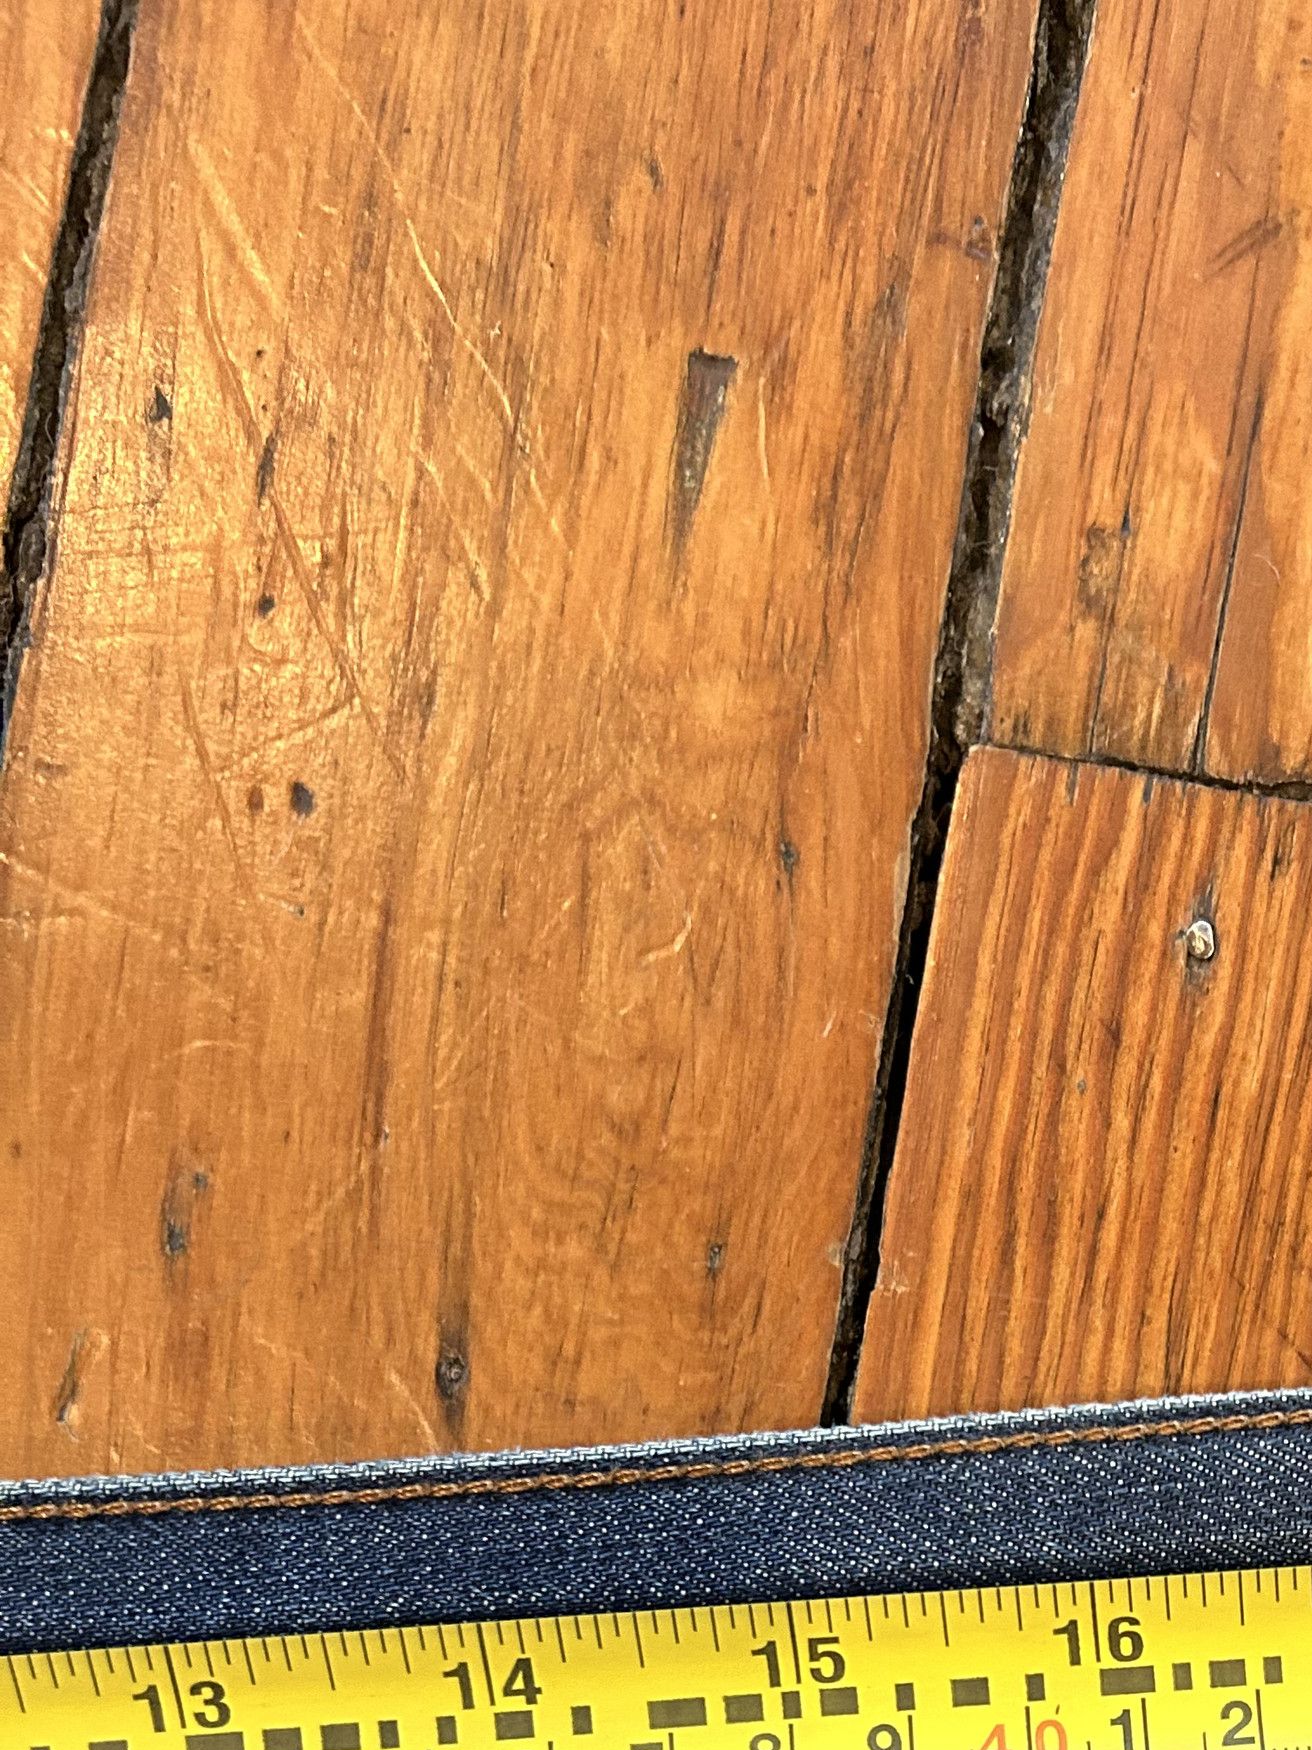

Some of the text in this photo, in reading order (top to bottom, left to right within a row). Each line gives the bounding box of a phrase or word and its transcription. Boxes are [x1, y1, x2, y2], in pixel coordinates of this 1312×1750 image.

[133, 1681, 232, 1733] 13
[443, 1657, 542, 1710] 14
[752, 1636, 846, 1688] 15
[1054, 1616, 1144, 1667] 16
[1220, 1700, 1256, 1746] 2
